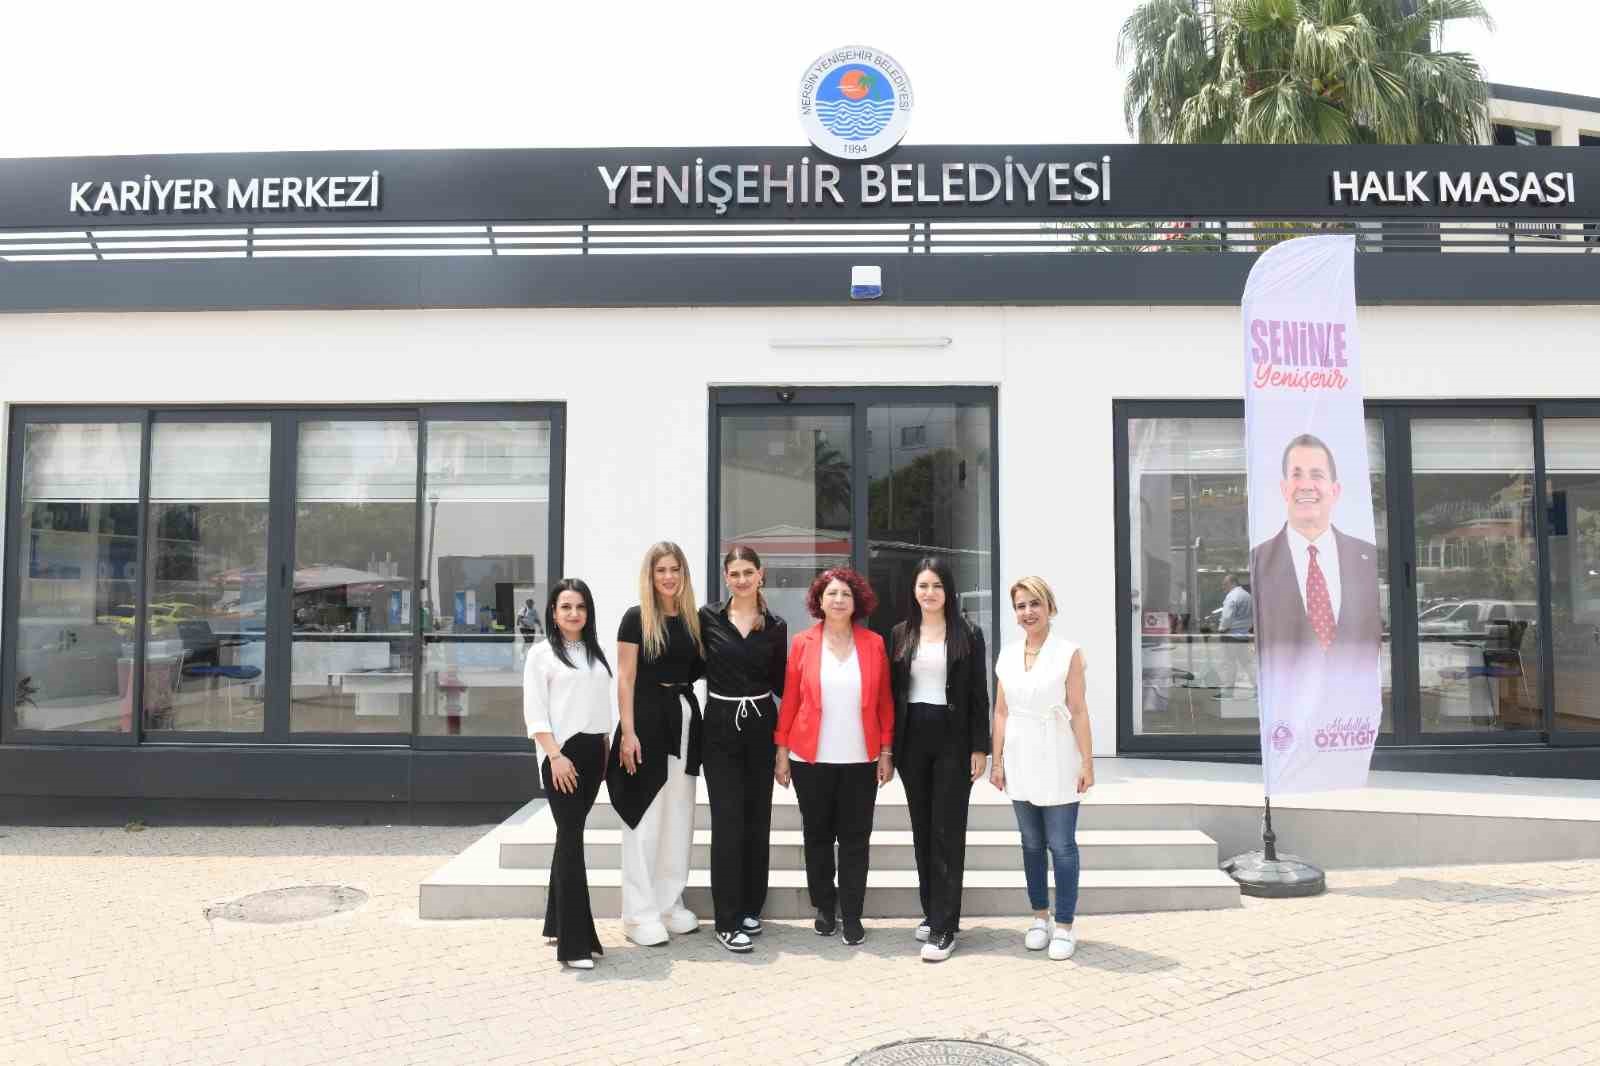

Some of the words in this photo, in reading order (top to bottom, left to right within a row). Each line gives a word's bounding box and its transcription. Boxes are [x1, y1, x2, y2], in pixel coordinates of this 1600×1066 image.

[69, 174, 217, 212] KARİYER
[226, 169, 379, 209] MERKEZİ
[597, 157, 845, 215] YENİŞEHİR
[860, 155, 1111, 203] BELEDİYESİ
[1332, 170, 1431, 202] HALK
[1439, 171, 1576, 203] MASASI
